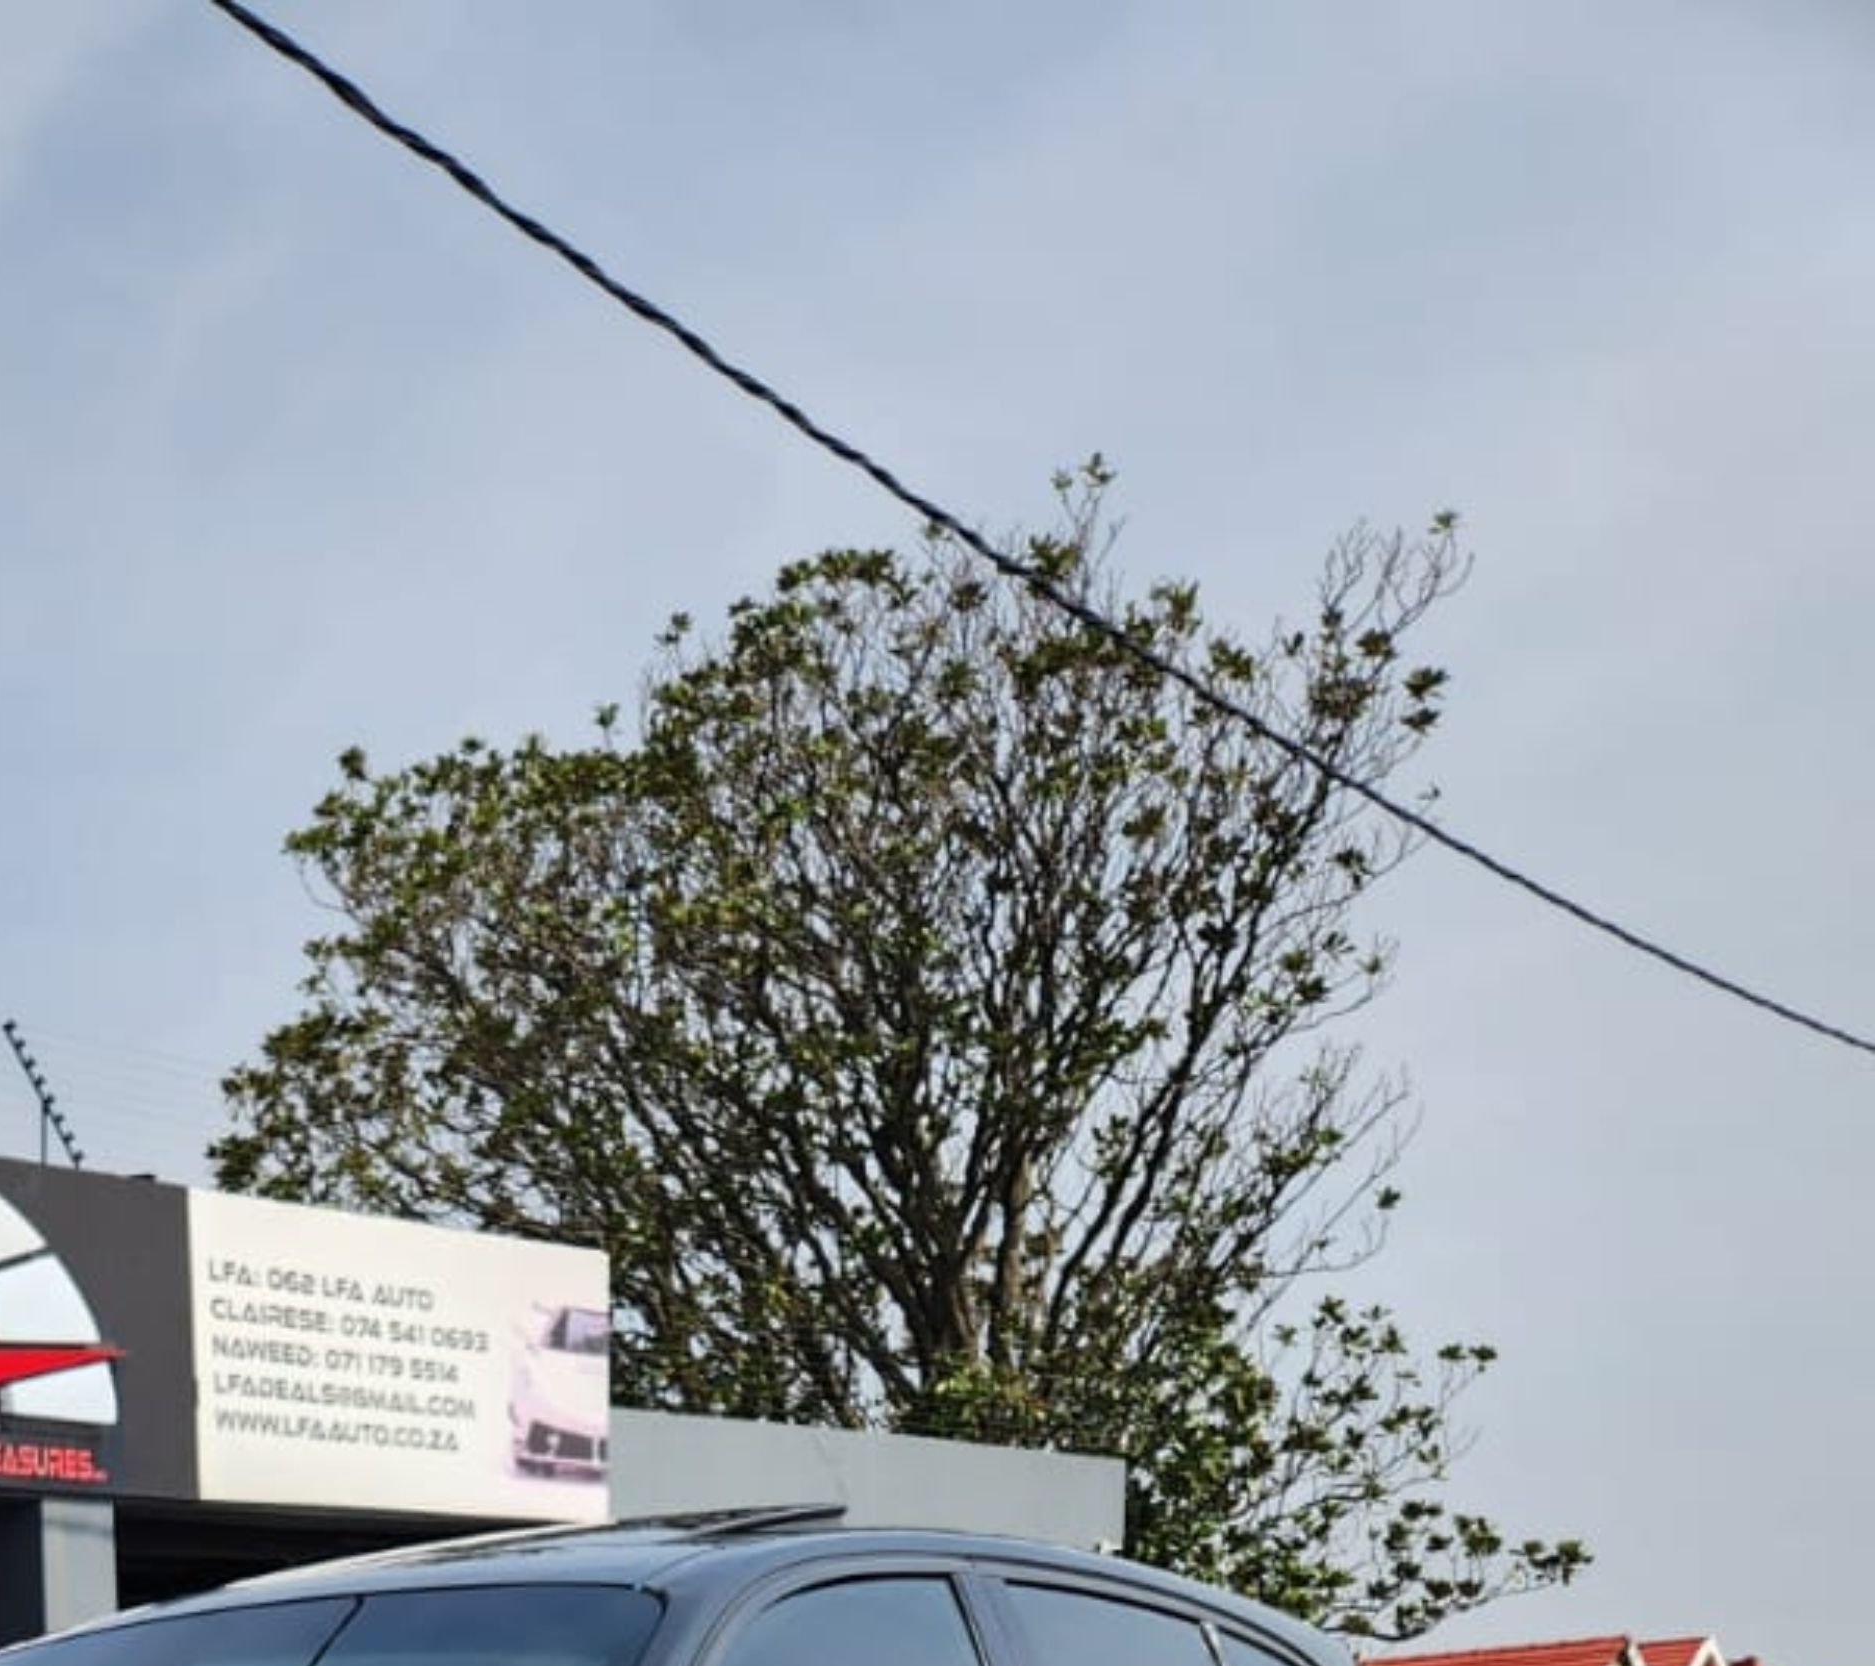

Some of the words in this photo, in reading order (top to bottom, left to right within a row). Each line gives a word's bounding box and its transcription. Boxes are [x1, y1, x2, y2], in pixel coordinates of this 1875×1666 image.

[208, 1258, 261, 1287] LFA:
[323, 1277, 365, 1302] LFA
[372, 1285, 435, 1312] AUTO
[215, 1407, 460, 1451] WWW.LFAAUTO.CO.ZA
